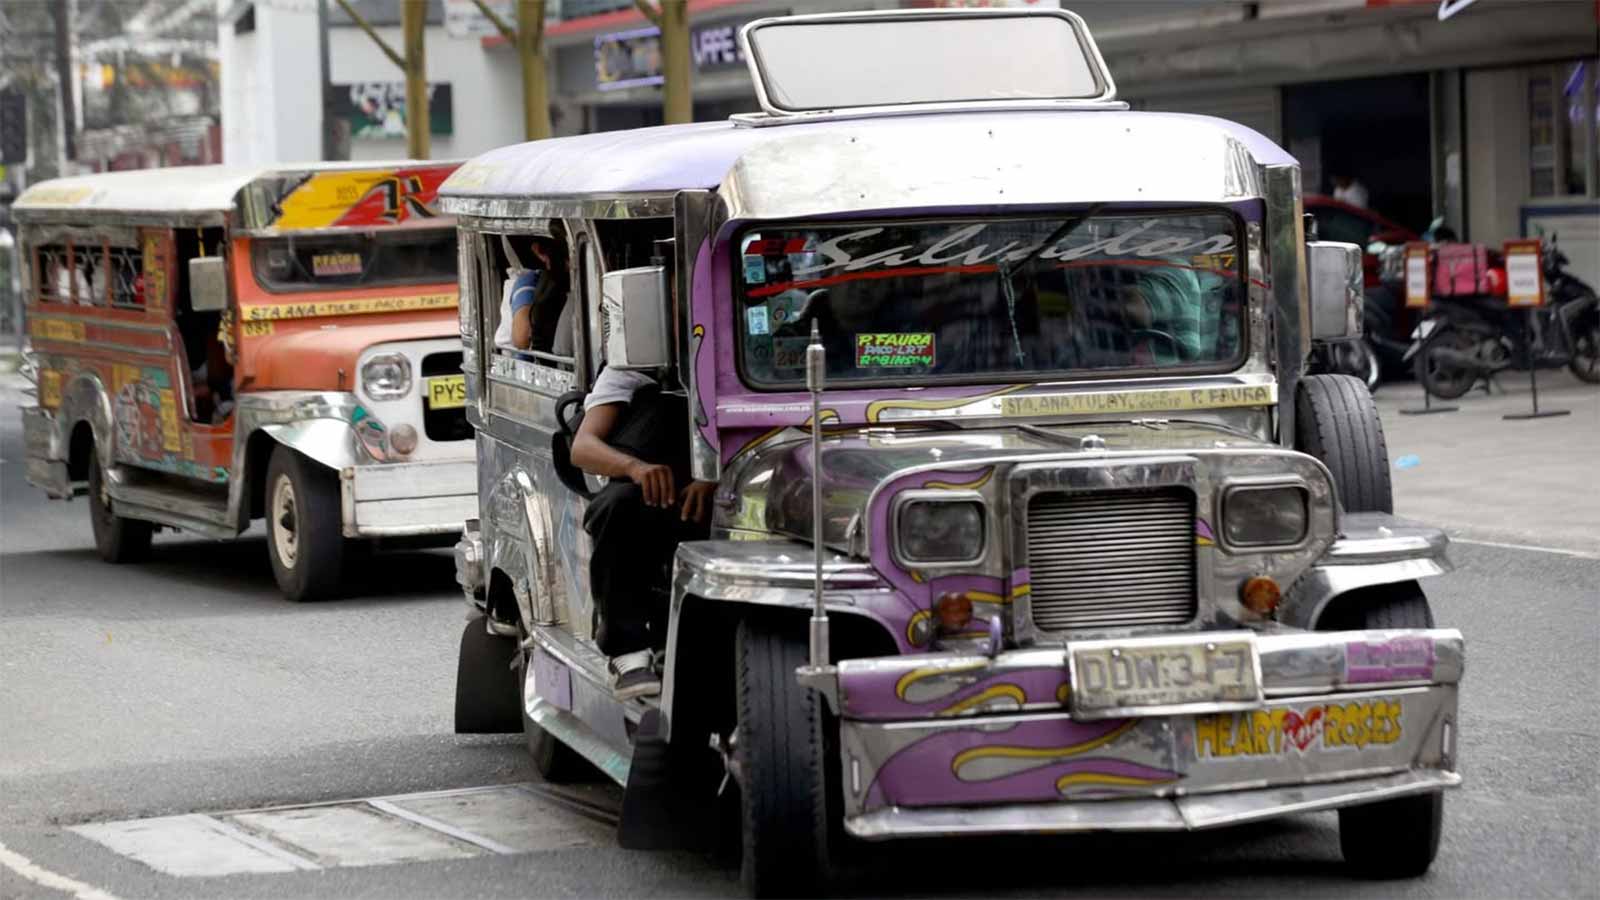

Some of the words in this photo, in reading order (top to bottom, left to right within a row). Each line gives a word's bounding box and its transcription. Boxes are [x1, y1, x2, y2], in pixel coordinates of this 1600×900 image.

[876, 334, 931, 346] FAURA
[860, 355, 932, 366] ROBINSON
[1208, 385, 1267, 402] FAURA
[1196, 707, 1289, 757] HEART
[1324, 701, 1402, 750] ROSES
